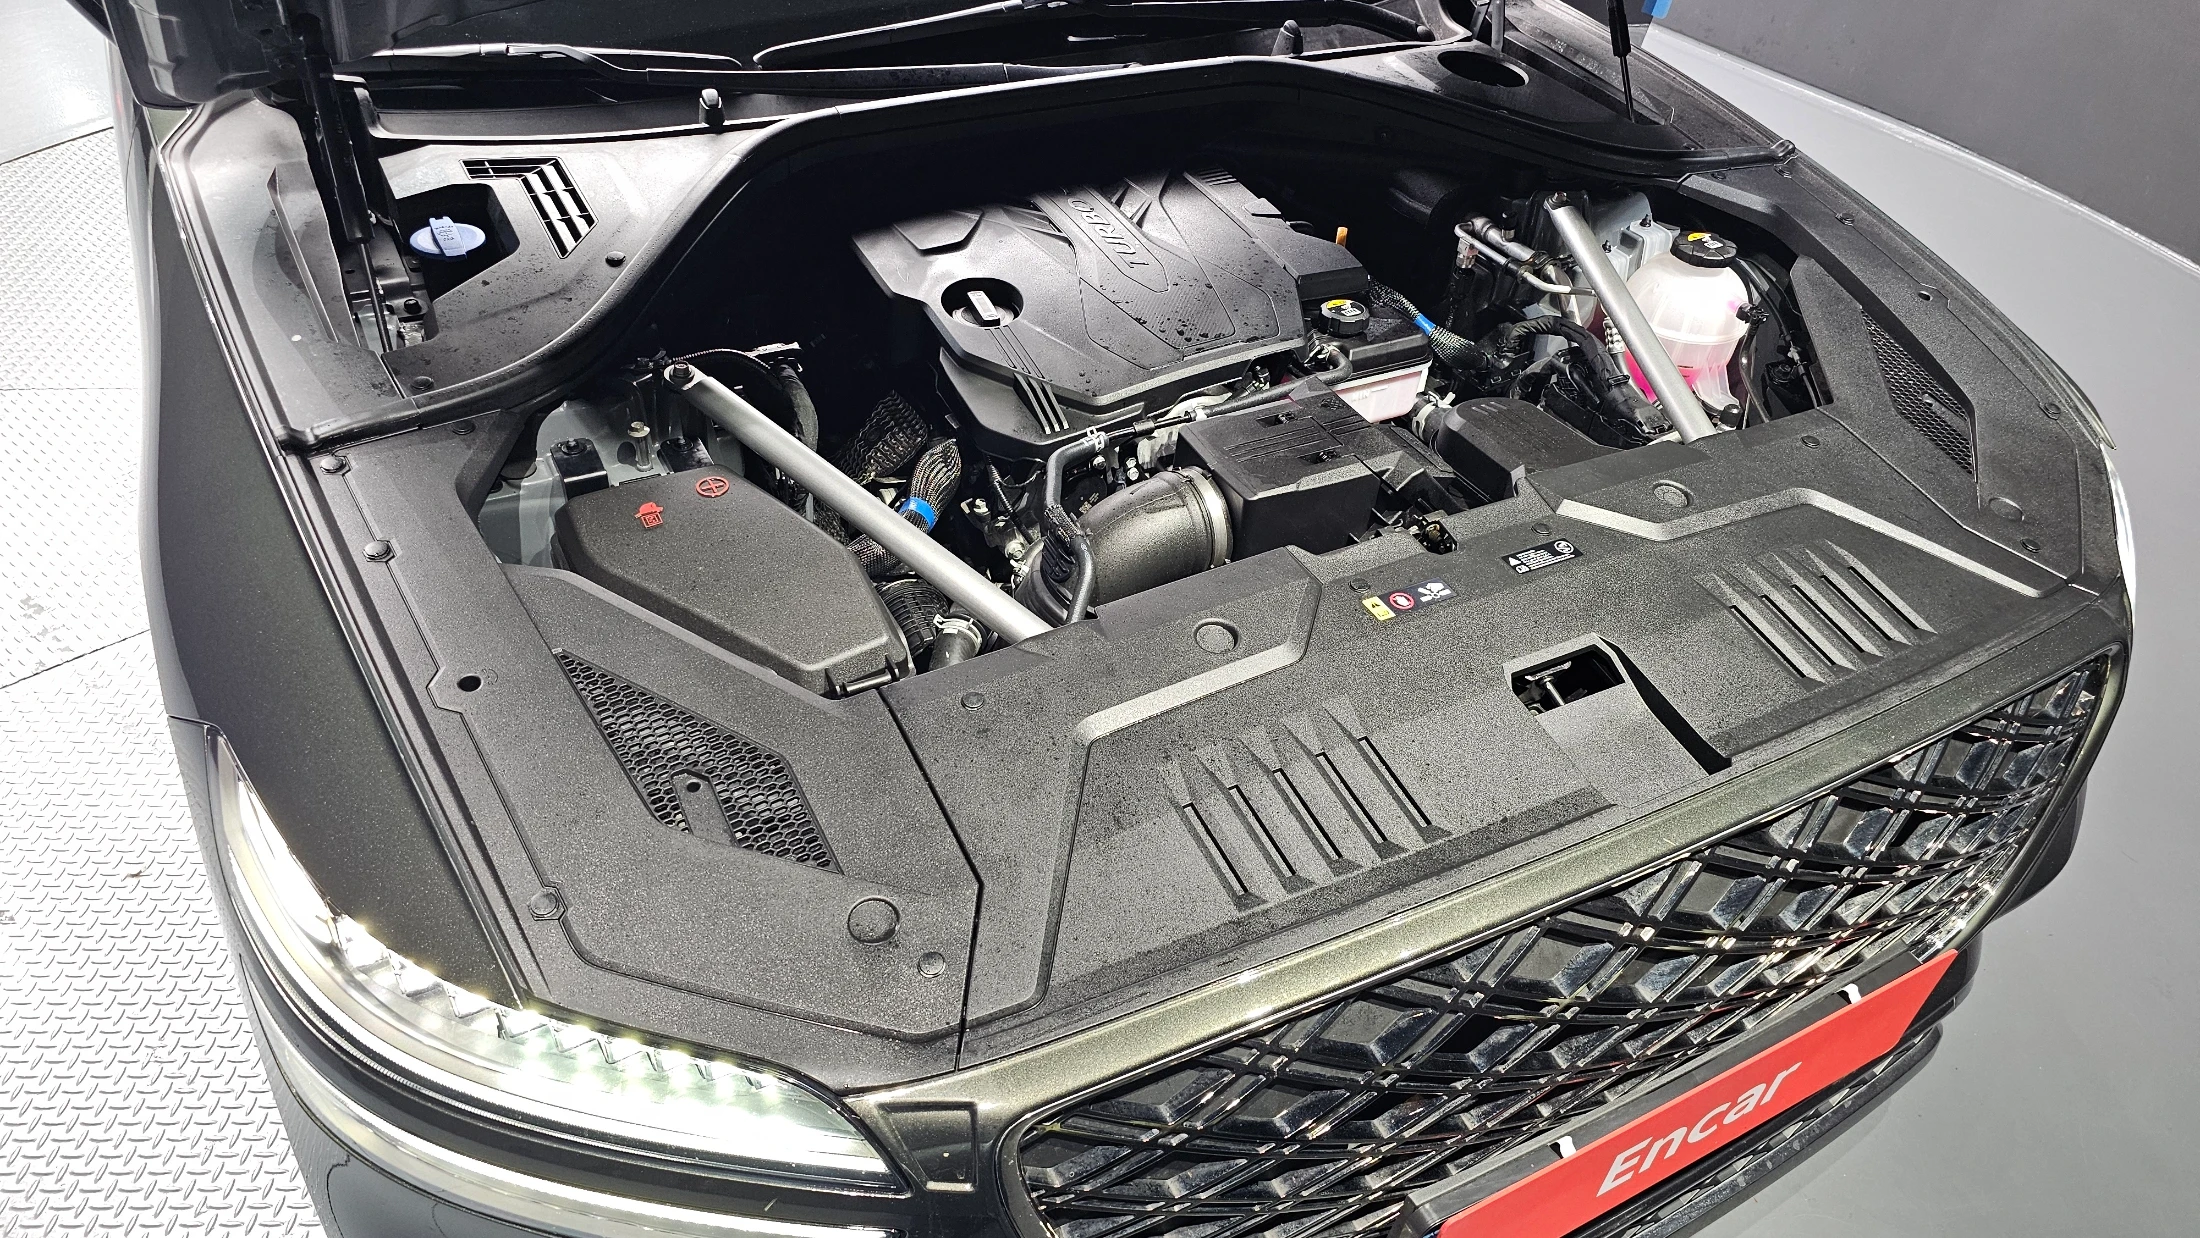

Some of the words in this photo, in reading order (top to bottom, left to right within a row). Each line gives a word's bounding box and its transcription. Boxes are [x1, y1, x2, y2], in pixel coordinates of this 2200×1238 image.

[1067, 197, 1150, 269] TURBO
[1351, 389, 1371, 401] MIN
[1596, 1062, 1803, 1197] Encar
